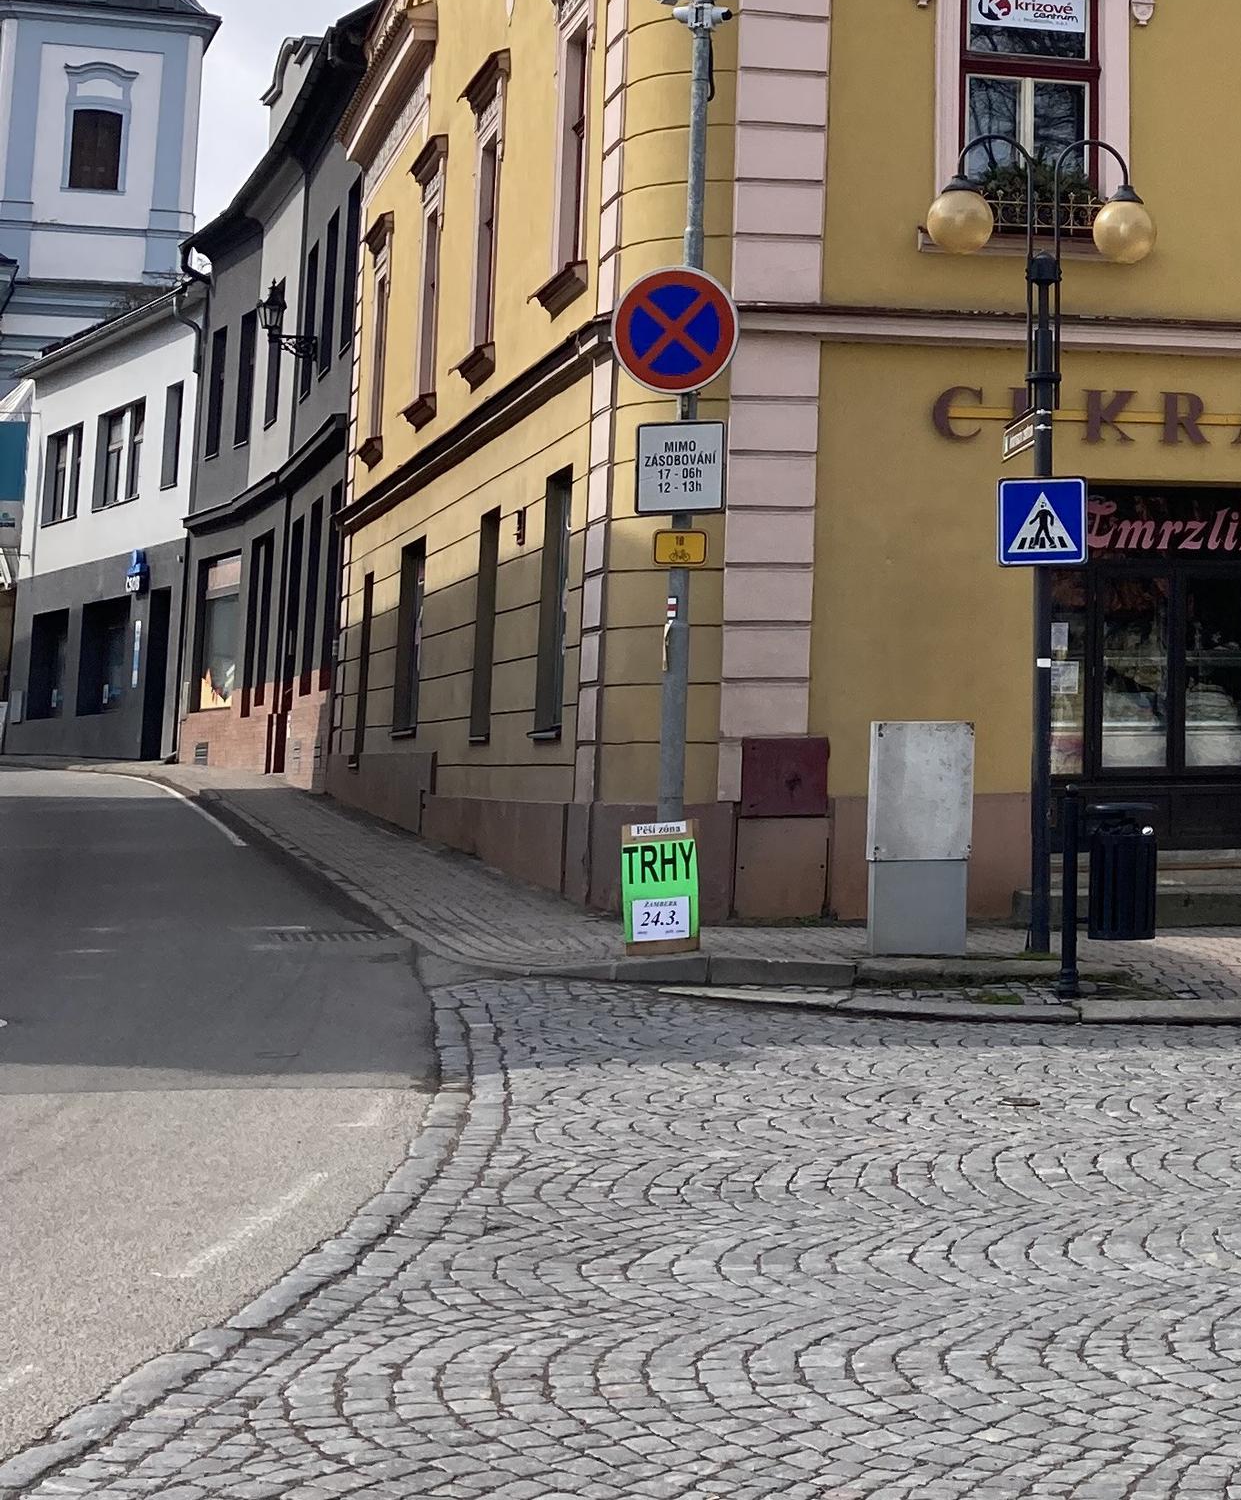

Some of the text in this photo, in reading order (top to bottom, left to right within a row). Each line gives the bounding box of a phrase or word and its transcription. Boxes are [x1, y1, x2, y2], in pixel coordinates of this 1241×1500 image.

[1033, 11, 1078, 23] centrum
[664, 440, 697, 452] MIMO
[644, 450, 716, 467] ZÁSOBOVÁNÍ
[658, 469, 671, 480] 17
[682, 467, 702, 479] 06h
[658, 482, 671, 493] 12
[682, 481, 702, 492] 13h
[658, 822, 681, 834] zóna
[622, 841, 694, 884] TRHY
[640, 909, 680, 926] 24.3.
